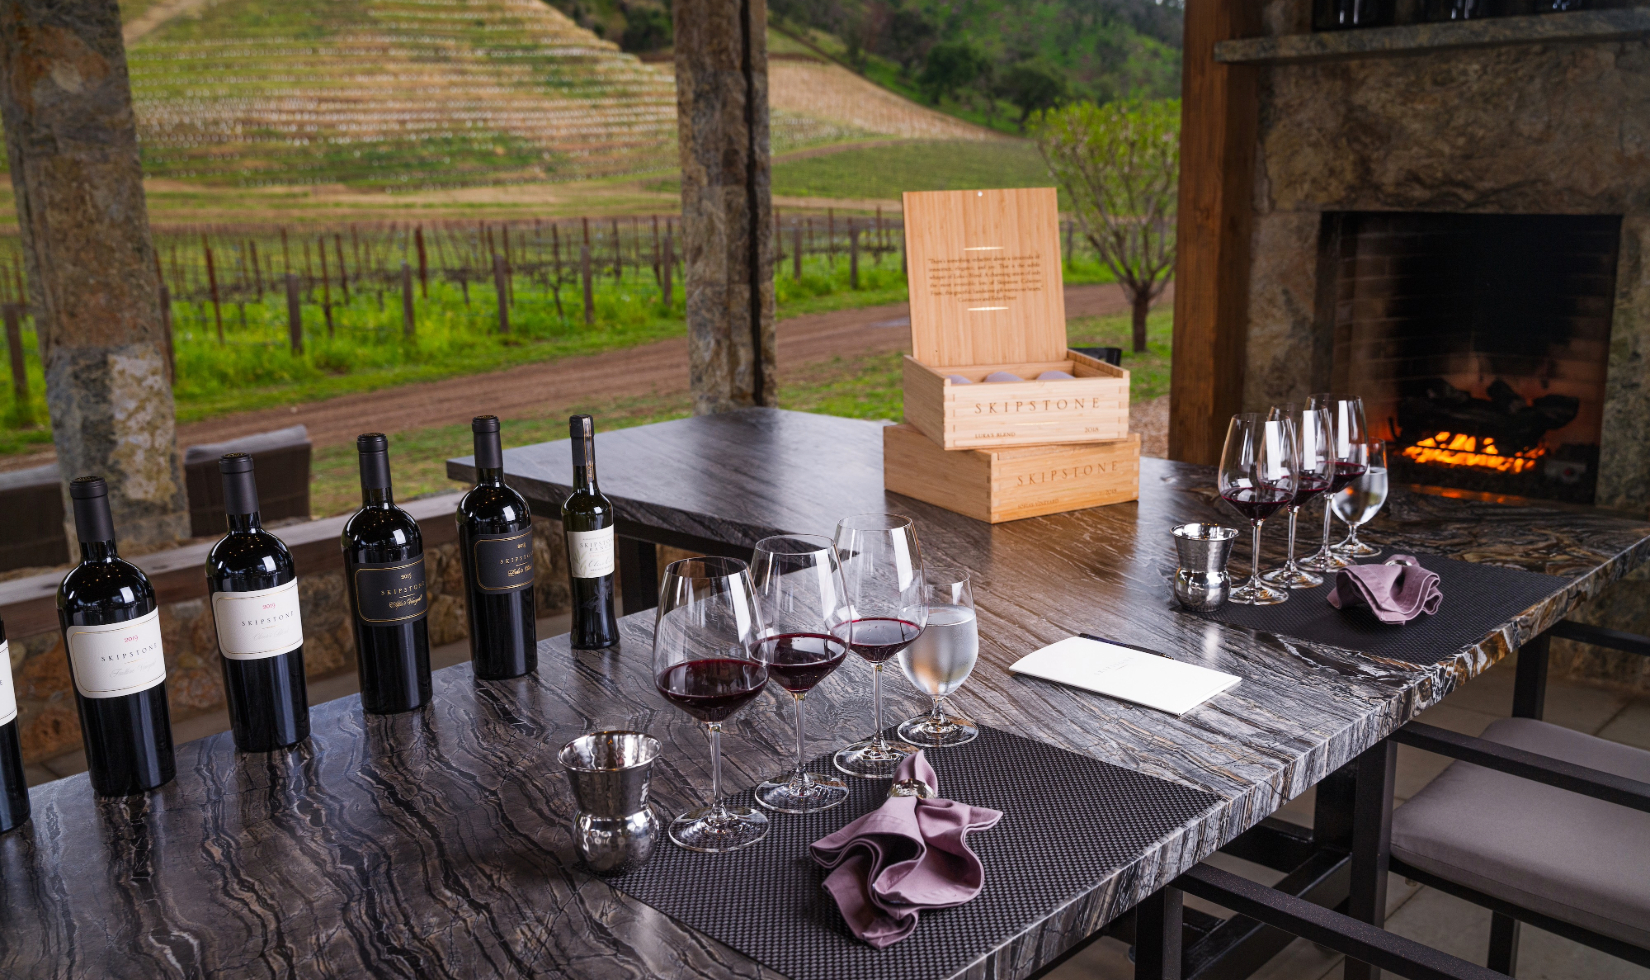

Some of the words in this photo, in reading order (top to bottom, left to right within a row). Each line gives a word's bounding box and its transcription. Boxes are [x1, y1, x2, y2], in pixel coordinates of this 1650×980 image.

[974, 397, 1100, 414] SKIPSTONE
[1017, 461, 1119, 486] SKIPSTONE
[241, 610, 294, 626] SKIPSTONE
[124, 635, 139, 643] 2019
[101, 642, 158, 662] SKIPSTONE
